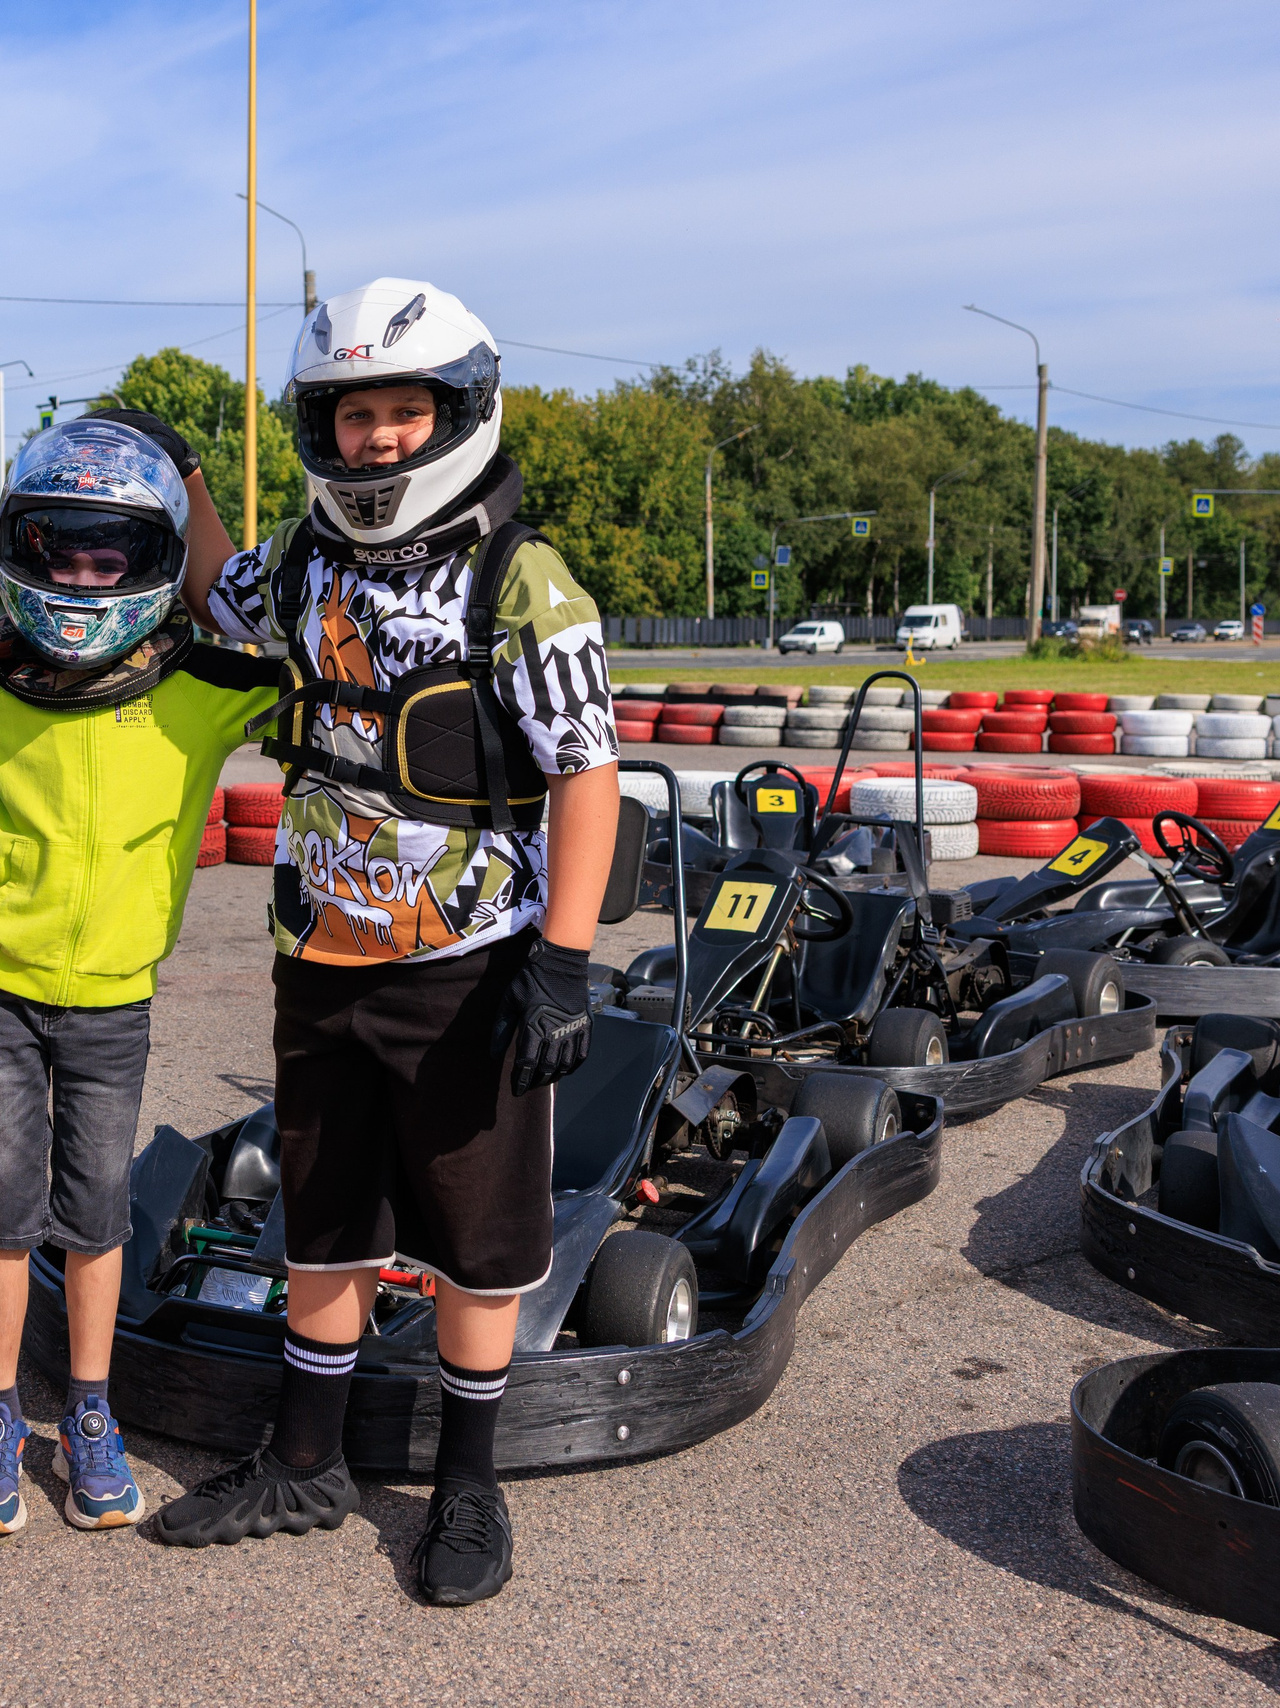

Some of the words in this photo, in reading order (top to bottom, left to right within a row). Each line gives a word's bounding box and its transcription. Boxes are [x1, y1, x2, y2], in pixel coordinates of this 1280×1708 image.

[334, 344, 374, 360] GXT
[122, 701, 153, 709] COMBINE
[769, 795, 785, 807] 3
[1067, 849, 1092, 866] 4
[367, 843, 450, 908] ON
[726, 893, 759, 920] 11
